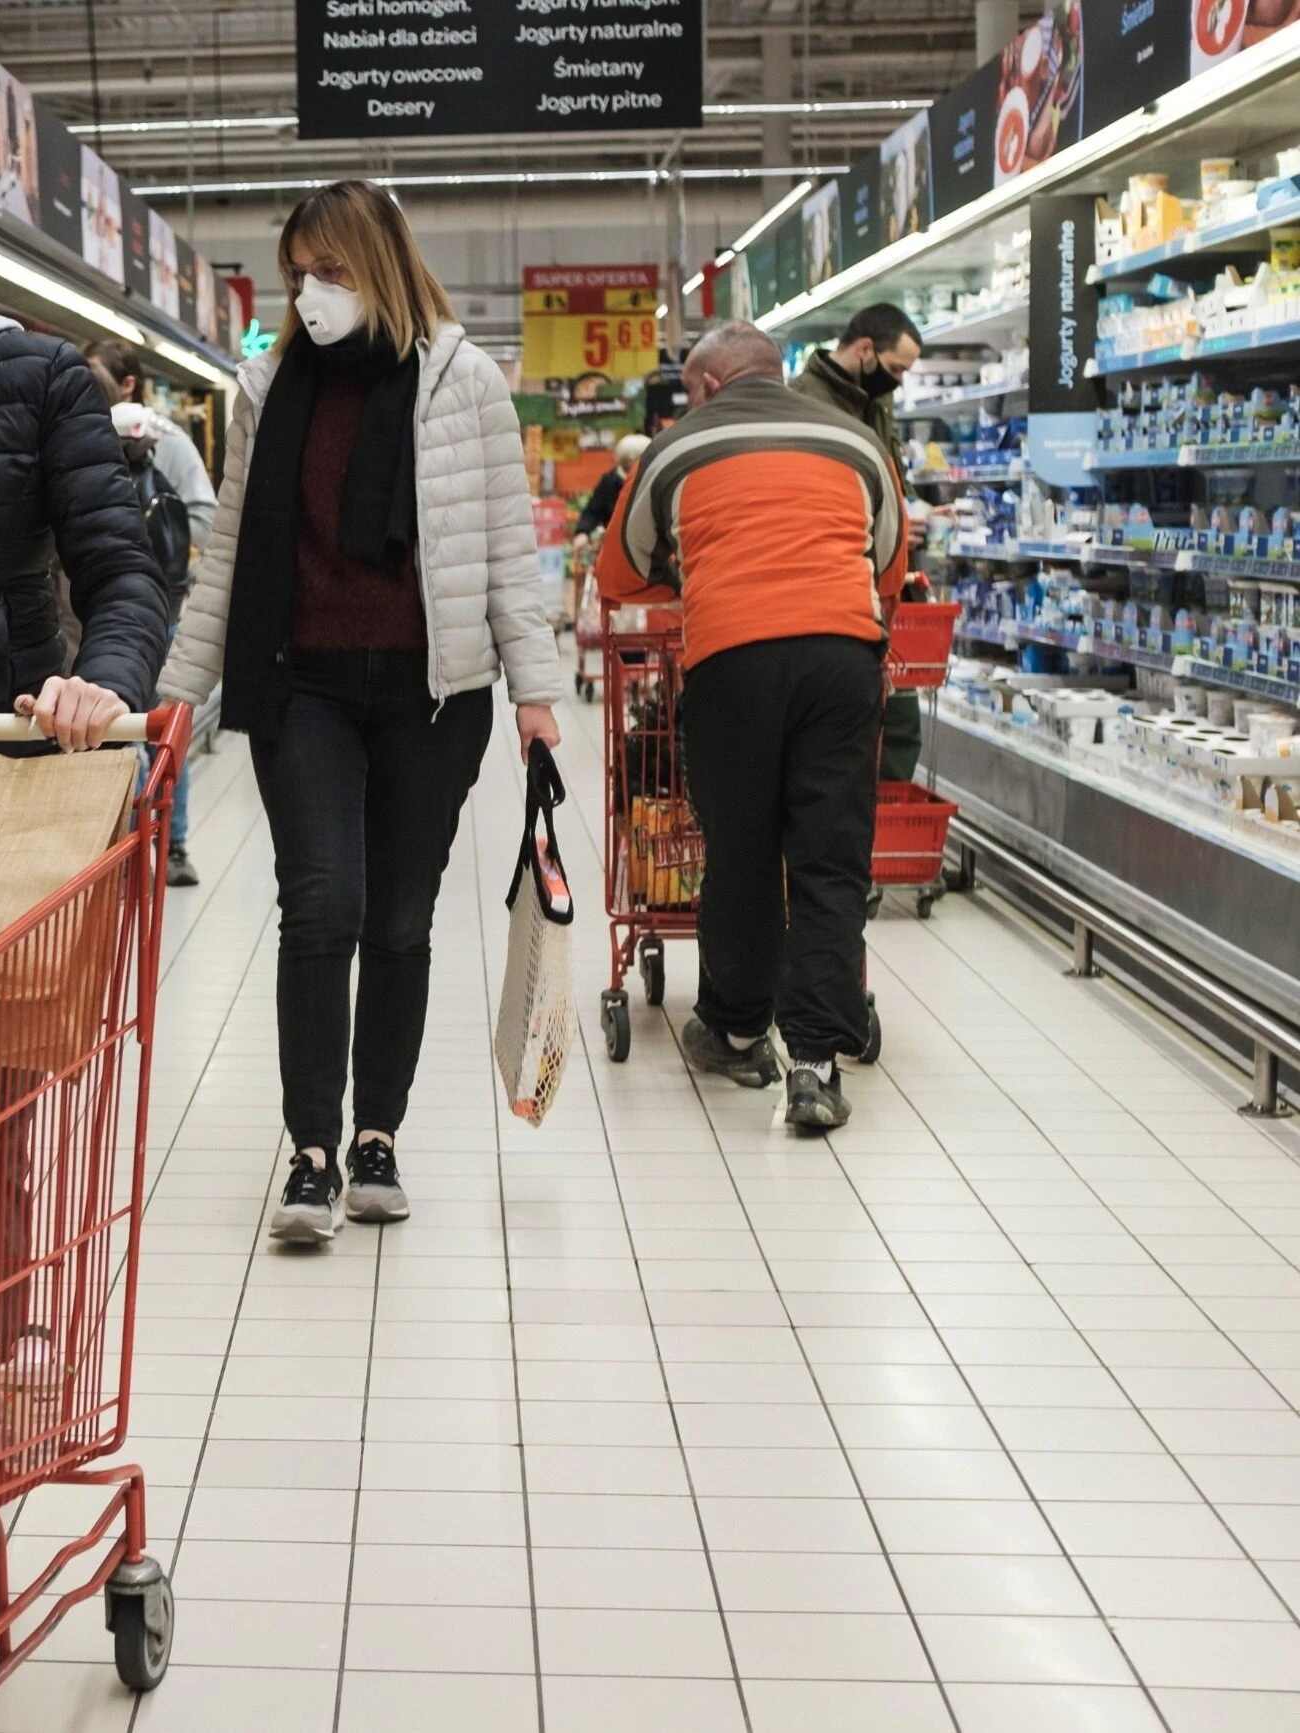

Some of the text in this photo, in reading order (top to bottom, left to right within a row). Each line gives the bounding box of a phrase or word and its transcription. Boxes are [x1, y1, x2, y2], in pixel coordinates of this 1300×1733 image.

[324, 26, 477, 49] Nabiał dla dzieci
[515, 20, 683, 45] Jogurty naturalne
[318, 66, 483, 89] Jogurty owocowe
[554, 56, 644, 80] Śmietany
[368, 99, 435, 118] Desery
[536, 91, 662, 114] Jogurty pitne
[1058, 219, 1075, 311] naturalne
[534, 271, 649, 287] SUPER OFERTA
[1058, 316, 1077, 389] Jogurty
